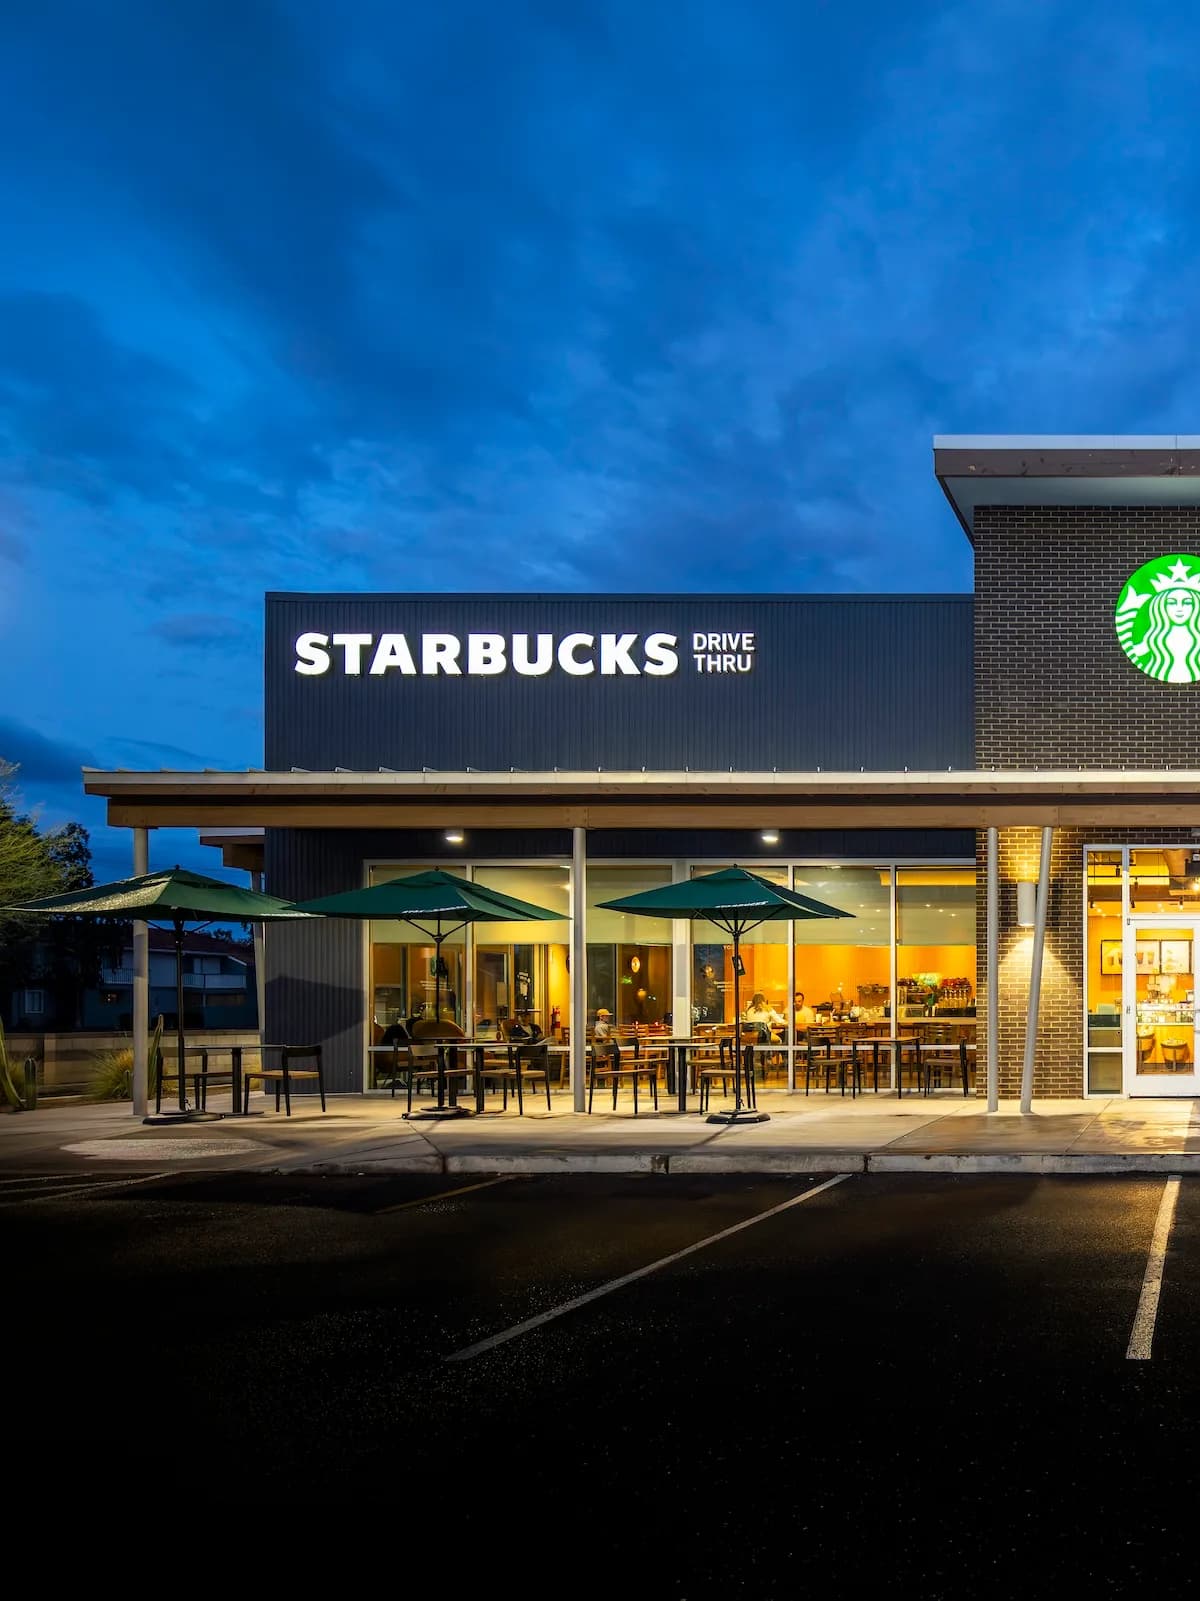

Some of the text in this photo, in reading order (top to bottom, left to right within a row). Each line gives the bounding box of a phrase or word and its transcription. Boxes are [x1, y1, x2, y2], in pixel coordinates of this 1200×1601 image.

[693, 632, 755, 651] DRIVE
[293, 631, 679, 676] STARBUCKS
[693, 653, 752, 673] THRU
